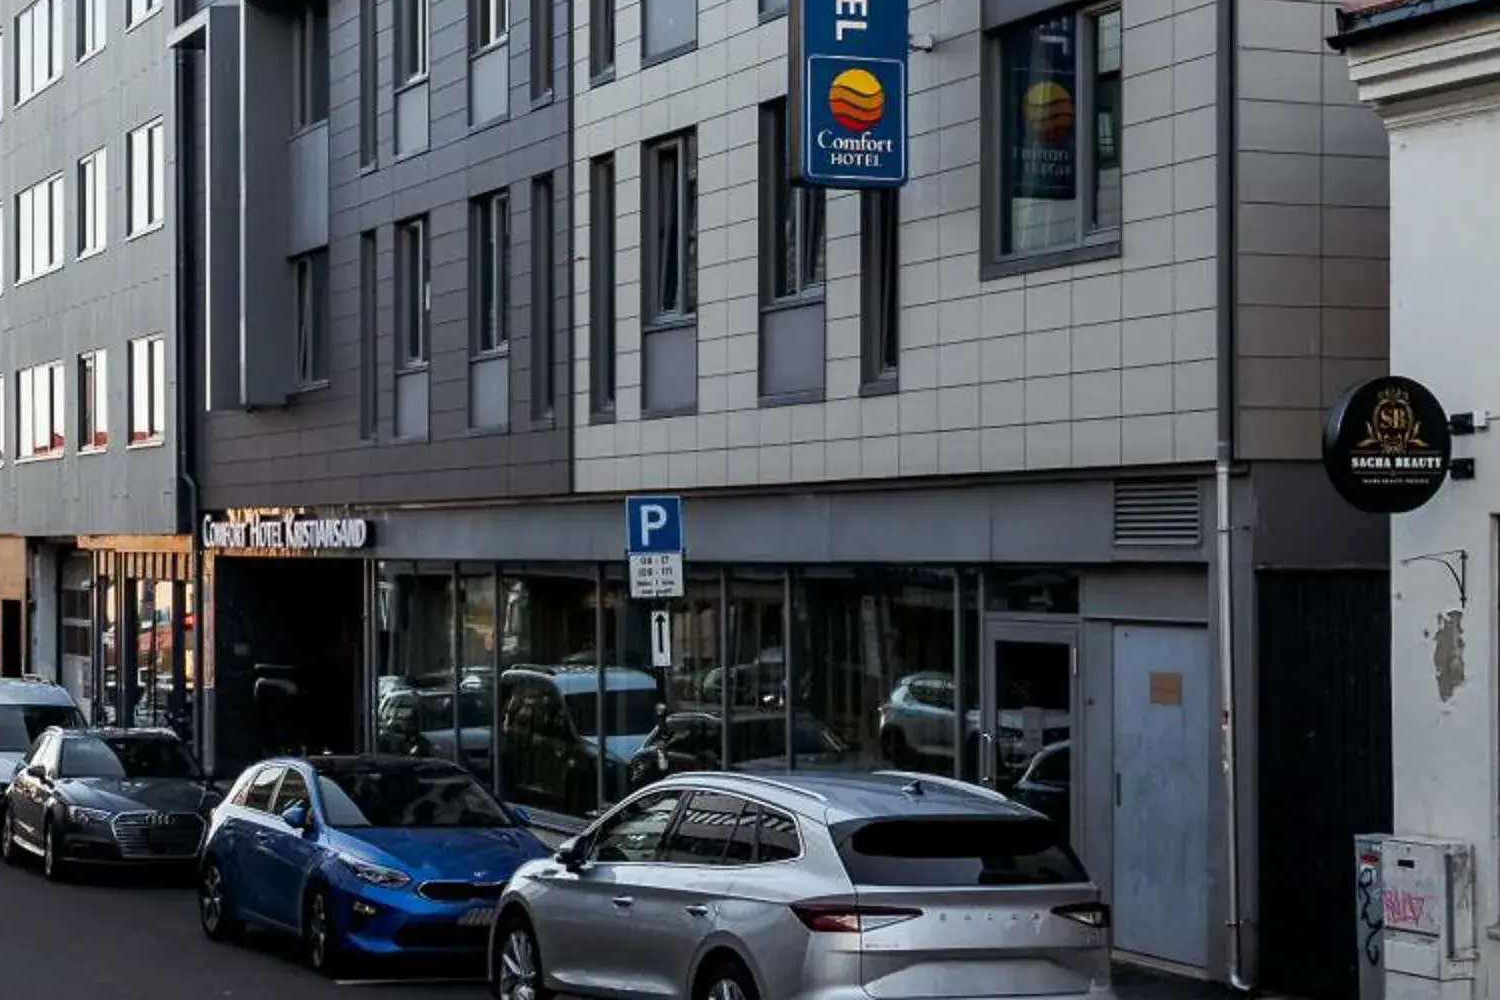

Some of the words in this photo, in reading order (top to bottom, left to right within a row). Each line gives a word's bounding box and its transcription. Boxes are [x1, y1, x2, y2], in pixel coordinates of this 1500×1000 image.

[817, 130, 893, 153] Comfort
[831, 153, 884, 167] HOTEL
[1351, 457, 1391, 469] SACHA
[1394, 457, 1442, 469] BEAUTY
[640, 504, 667, 546] P
